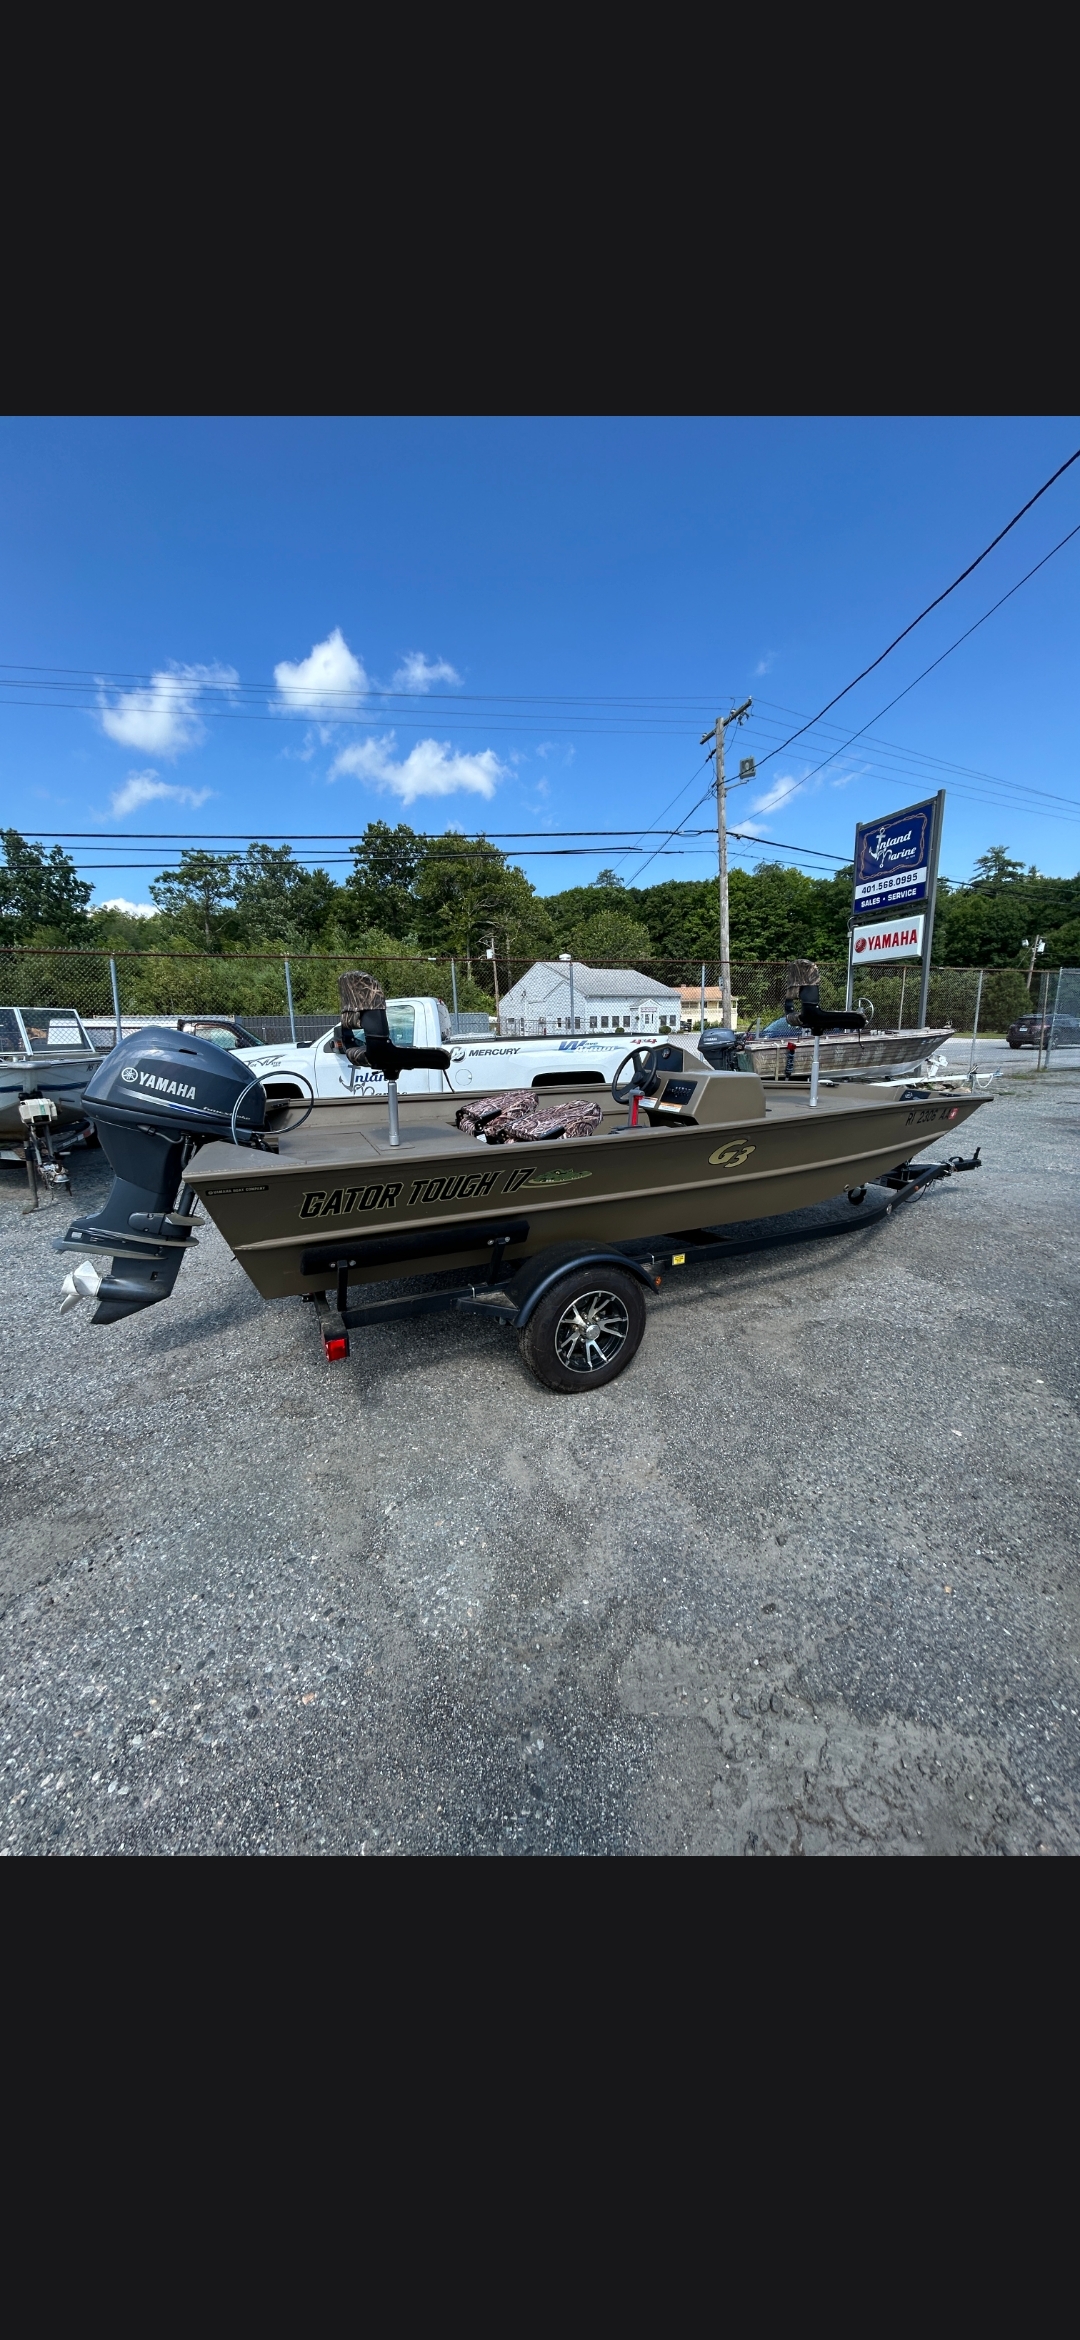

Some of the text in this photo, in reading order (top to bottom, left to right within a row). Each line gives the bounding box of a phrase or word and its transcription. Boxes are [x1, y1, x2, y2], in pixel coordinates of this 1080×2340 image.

[876, 847, 917, 867] Marine
[861, 873, 918, 894] 401.568.0995
[861, 888, 917, 908] SALES SERVICE
[867, 929, 918, 950] YAMAHA
[468, 1047, 521, 1057] MERCURY
[138, 1071, 197, 1100] YAMAHA
[708, 1139, 756, 1168] G3
[299, 1167, 538, 1220] GATOR TOUGH 17
